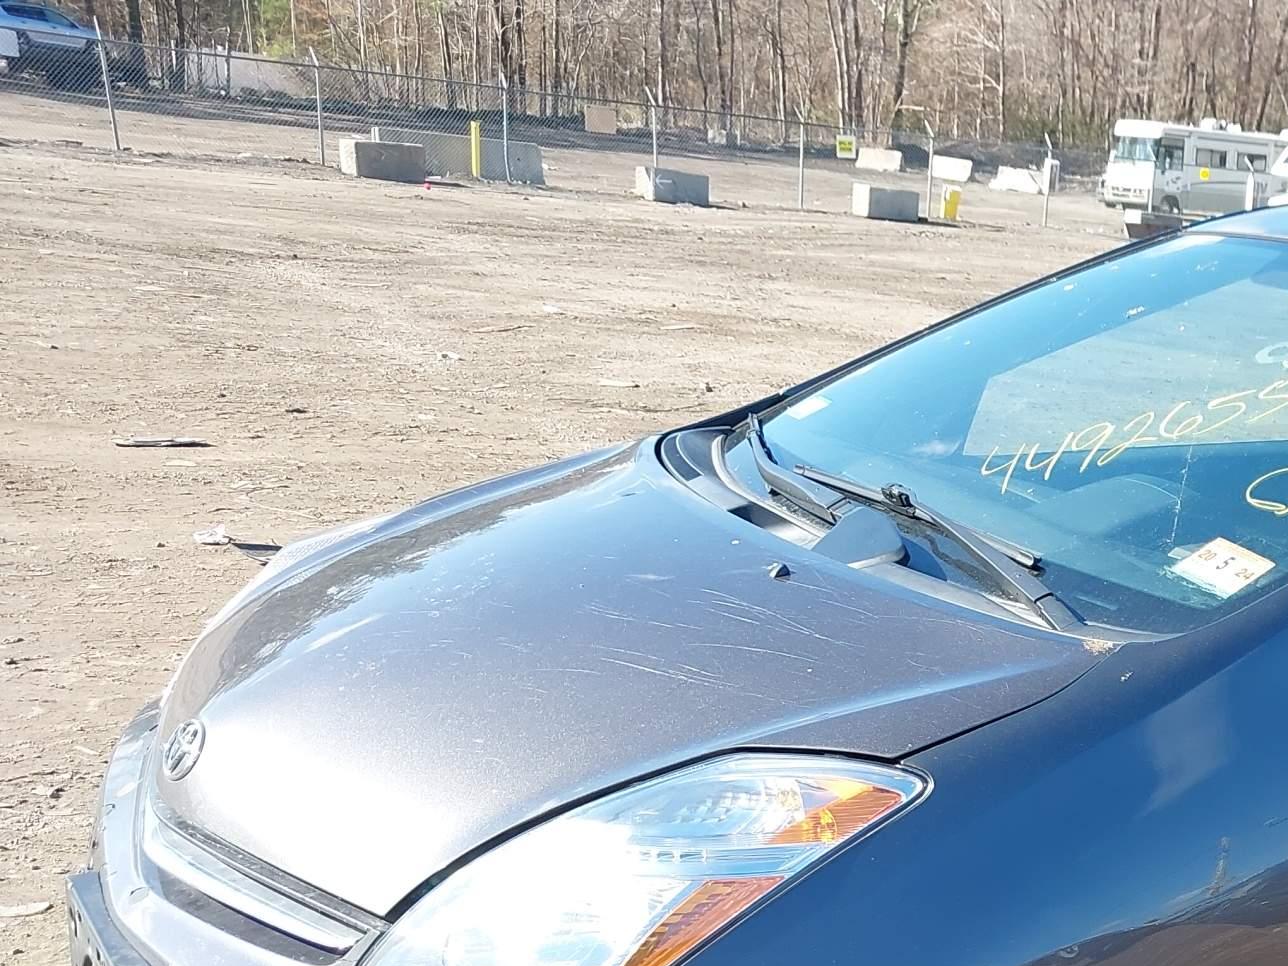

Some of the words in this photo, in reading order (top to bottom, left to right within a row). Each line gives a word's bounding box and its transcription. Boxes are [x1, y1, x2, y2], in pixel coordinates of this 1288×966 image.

[1198, 549, 1217, 561] 20
[1216, 556, 1236, 570] 5
[1235, 568, 1255, 580] 24
